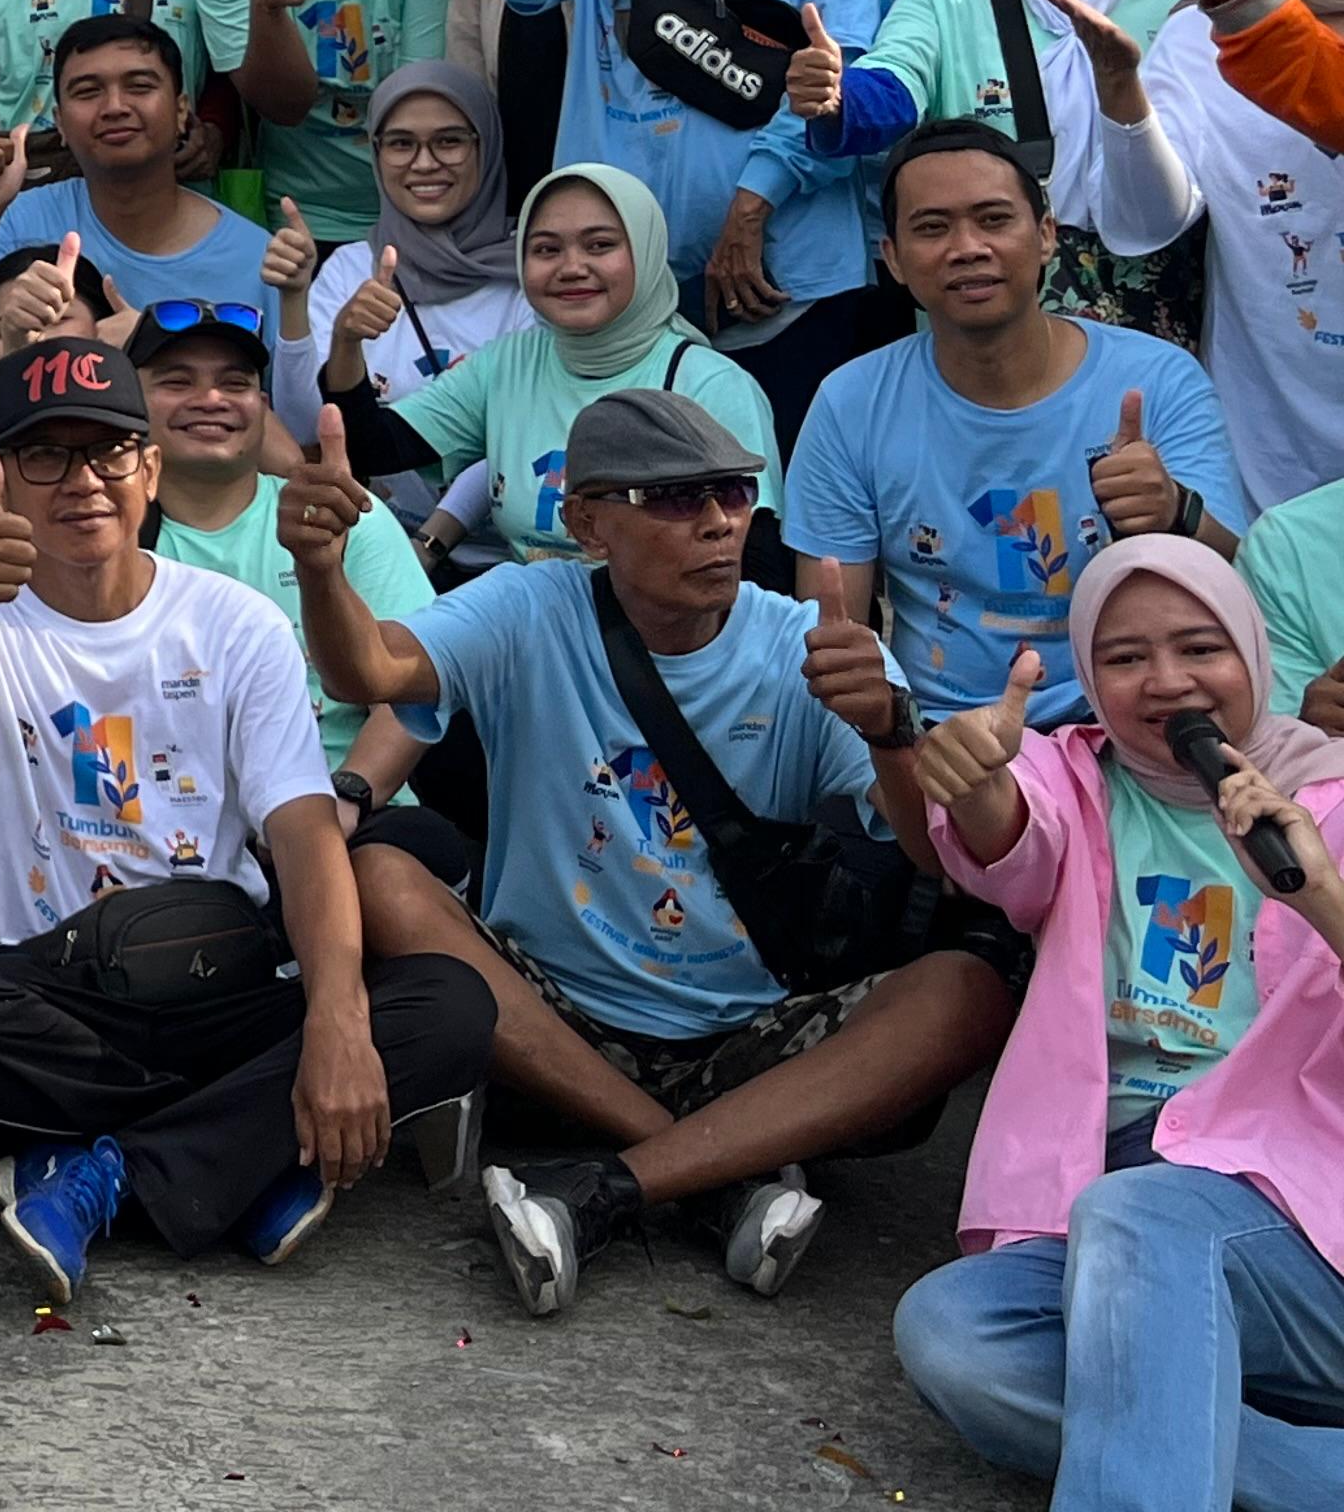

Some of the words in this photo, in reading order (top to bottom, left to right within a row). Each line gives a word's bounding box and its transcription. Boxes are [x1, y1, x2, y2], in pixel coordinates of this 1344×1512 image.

[655, 13, 764, 101] adidas
[22, 349, 112, 402] 11C
[55, 810, 142, 842] Tumbuh
